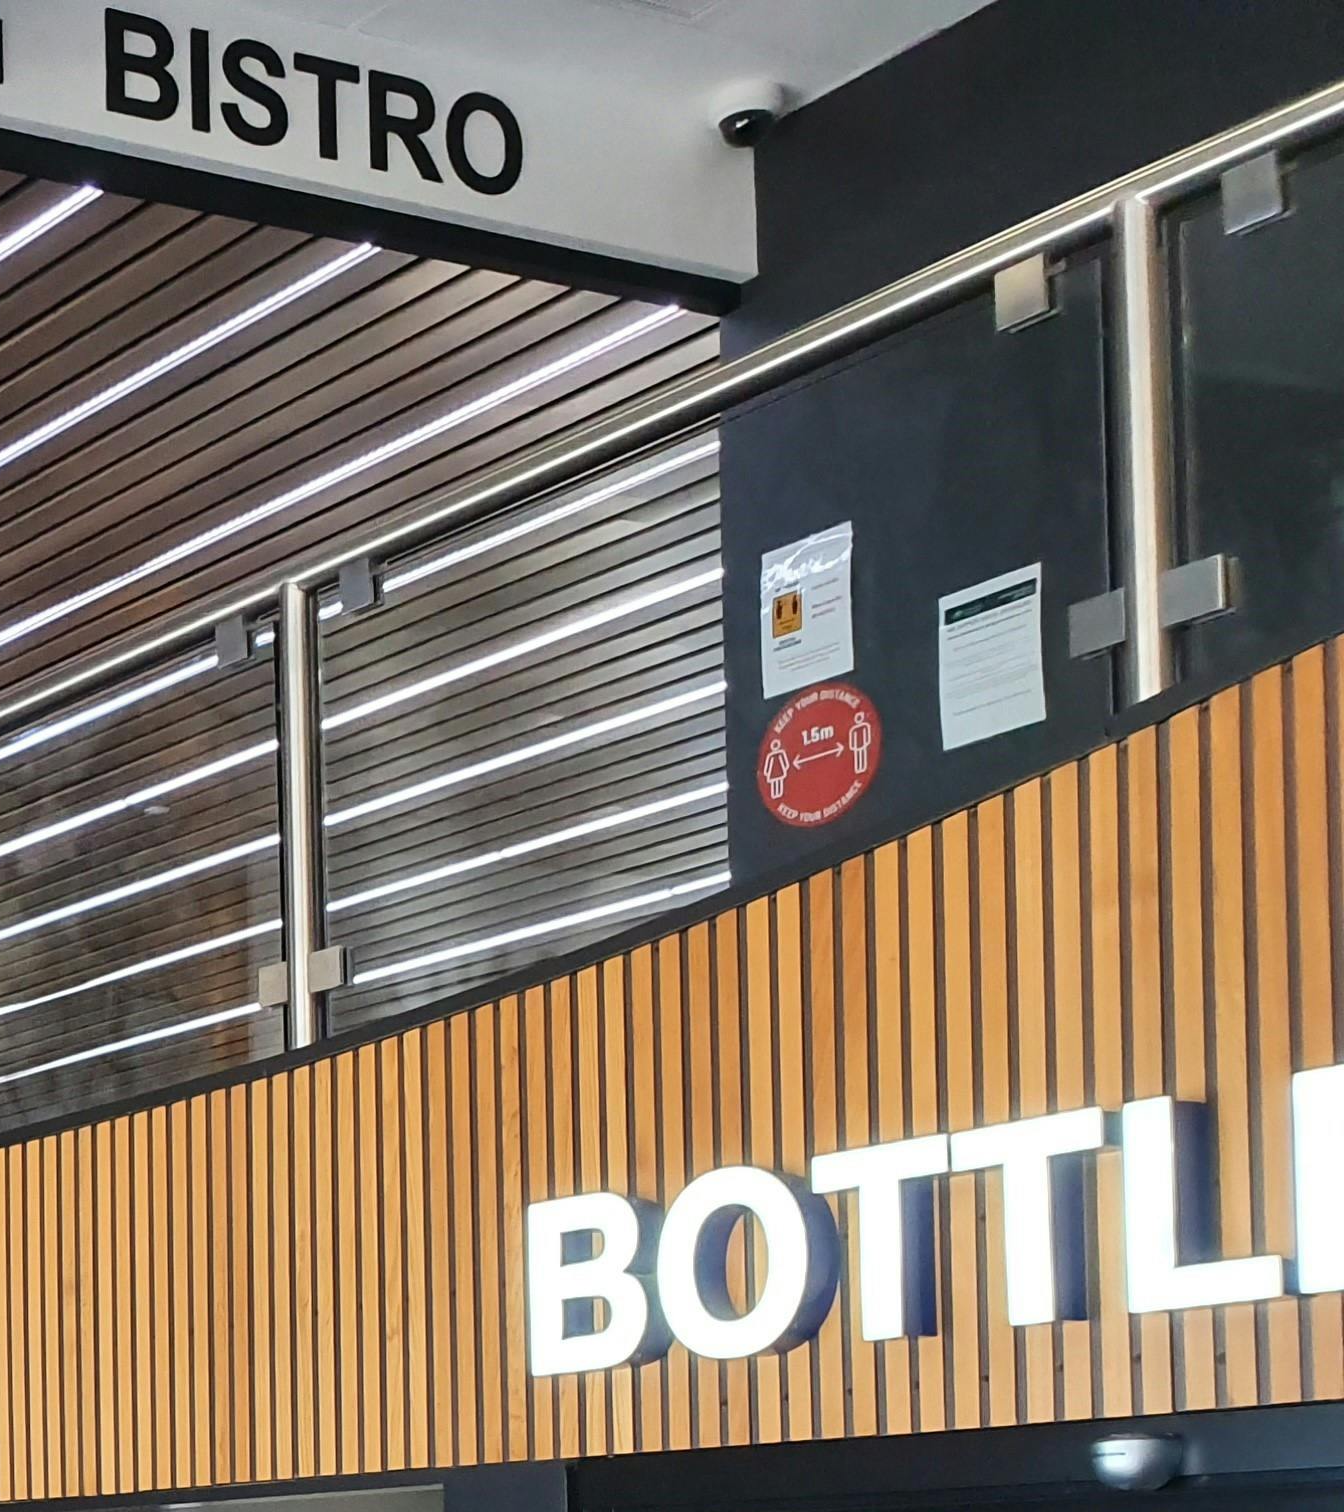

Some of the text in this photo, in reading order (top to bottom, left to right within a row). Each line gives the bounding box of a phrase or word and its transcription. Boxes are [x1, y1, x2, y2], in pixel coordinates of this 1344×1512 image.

[106, 8, 523, 195] BISTRO
[774, 689, 861, 733] KEEP YOUR DISTANCE
[777, 780, 862, 822] KEEP YOUR DISTANCE
